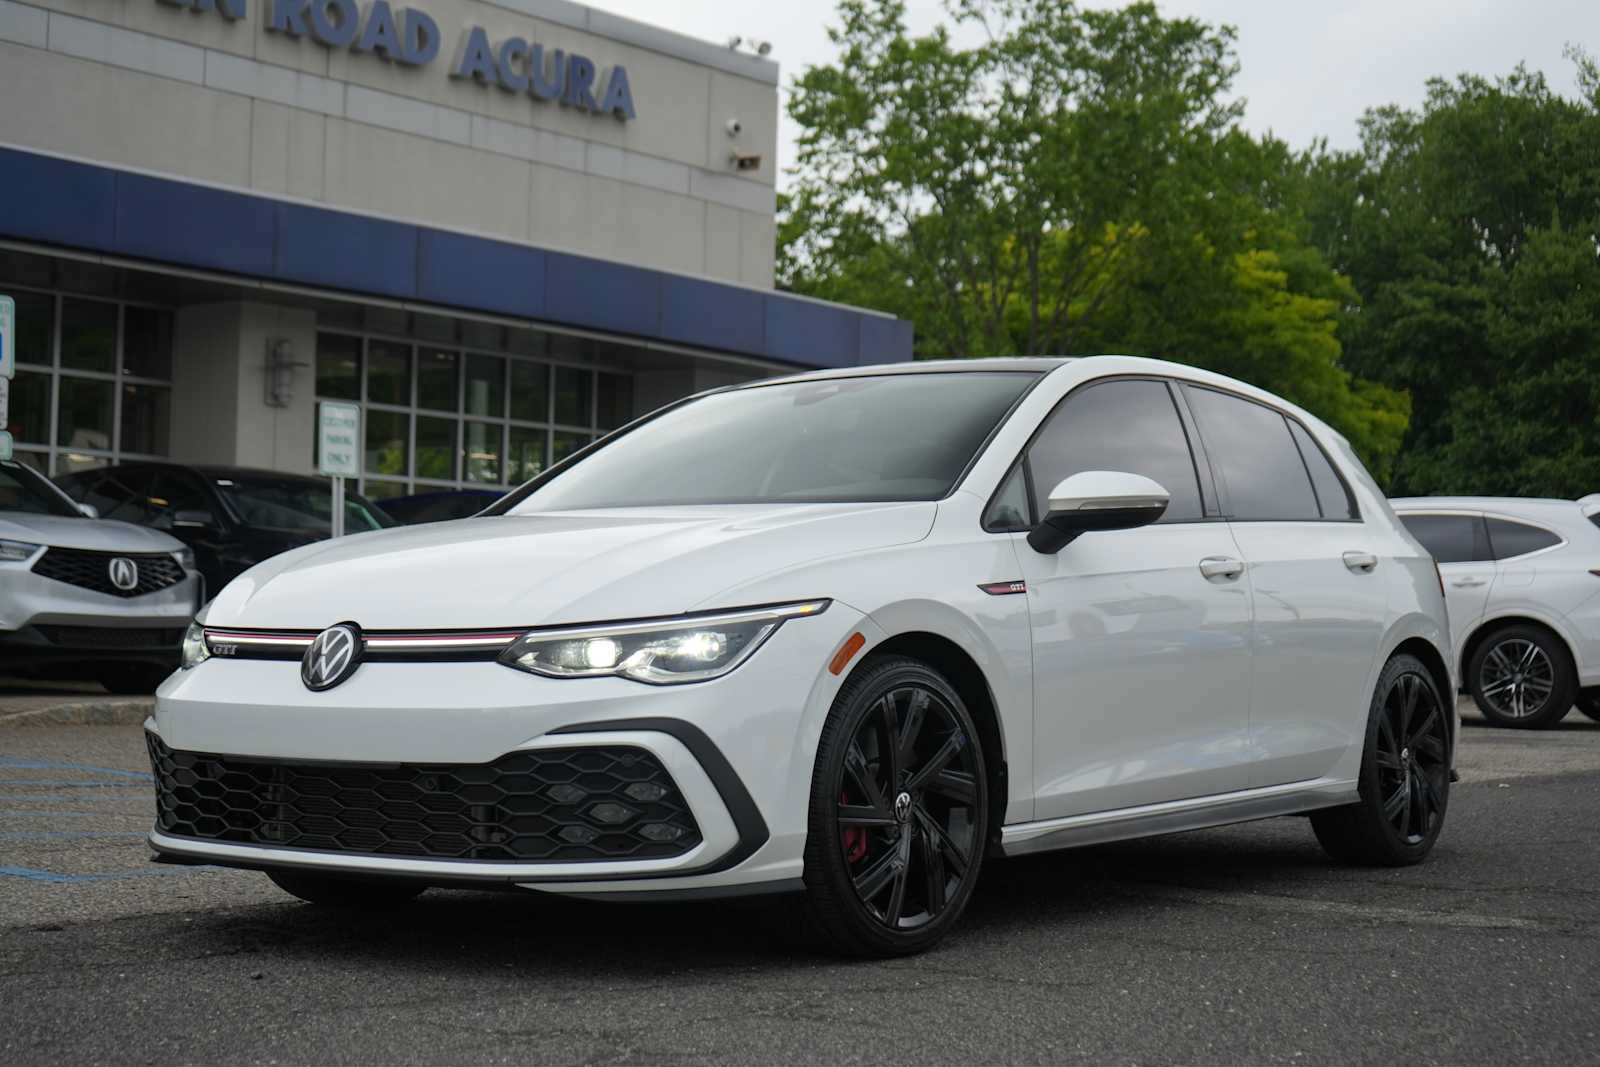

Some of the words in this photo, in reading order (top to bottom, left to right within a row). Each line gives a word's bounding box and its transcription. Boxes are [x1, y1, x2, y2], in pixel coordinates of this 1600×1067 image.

[268, 0, 441, 65] ROAD
[453, 25, 637, 121] ACURA
[1010, 584, 1025, 592] GTI
[213, 643, 238, 656] GTI
